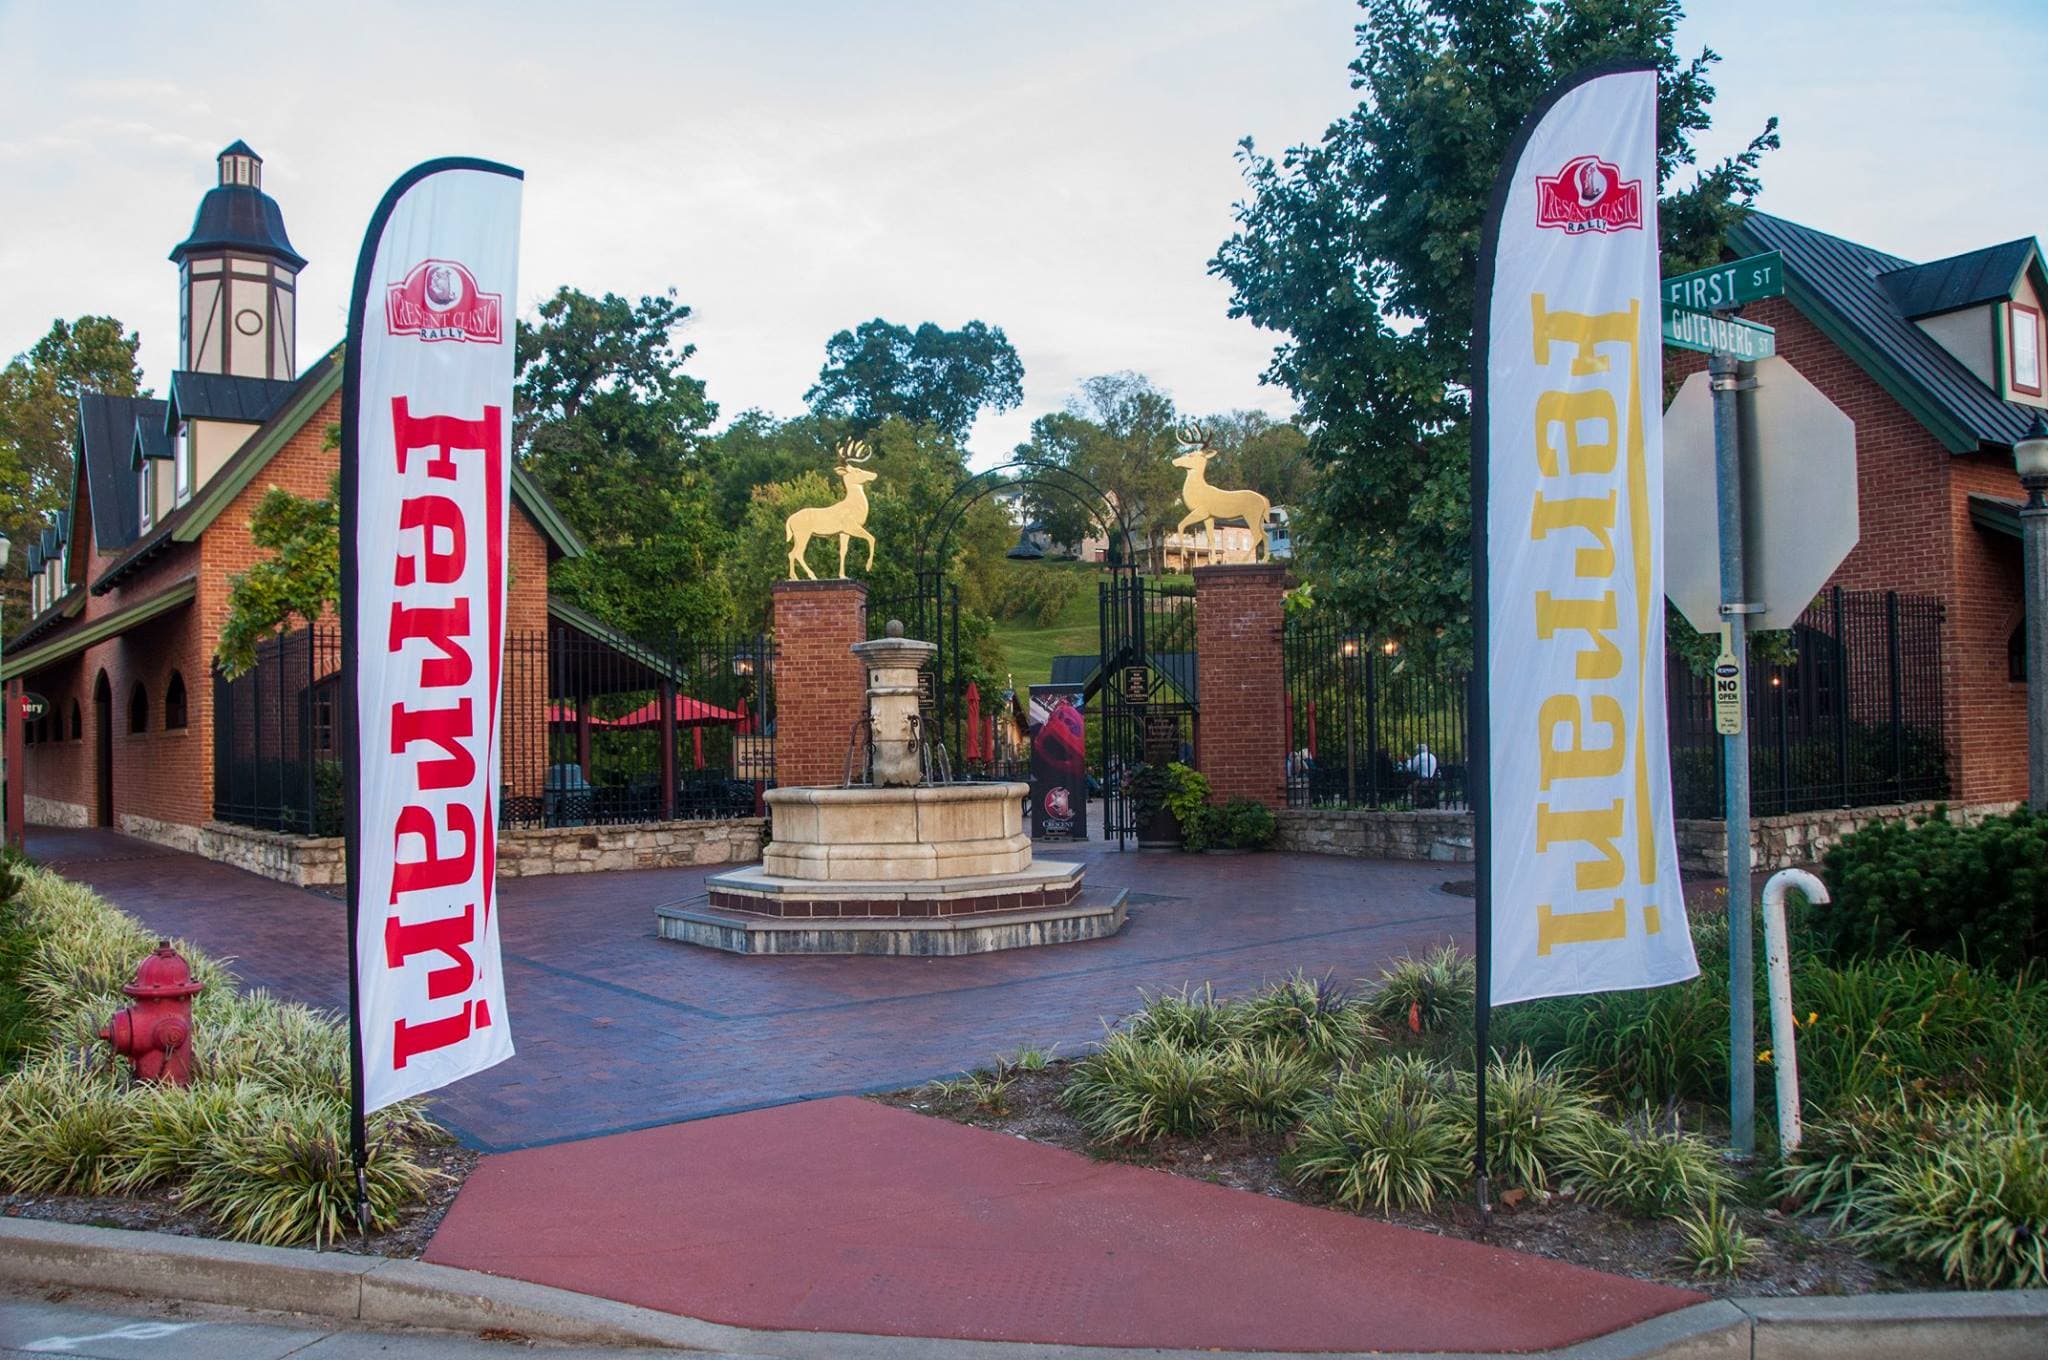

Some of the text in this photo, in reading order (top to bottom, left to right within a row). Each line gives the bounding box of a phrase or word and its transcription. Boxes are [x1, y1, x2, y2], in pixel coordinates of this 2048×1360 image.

[1568, 220, 1606, 232] RALLY
[1671, 267, 1771, 308] FIRST ST
[392, 290, 451, 328] CRESENT
[420, 328, 464, 339] RALLY
[1673, 308, 1769, 356] GUTENBERG ST
[1531, 292, 1661, 956] Ferrari
[1718, 680, 1737, 692] NO
[1718, 692, 1738, 701] OPEN
[386, 396, 502, 1070] Ferrari
